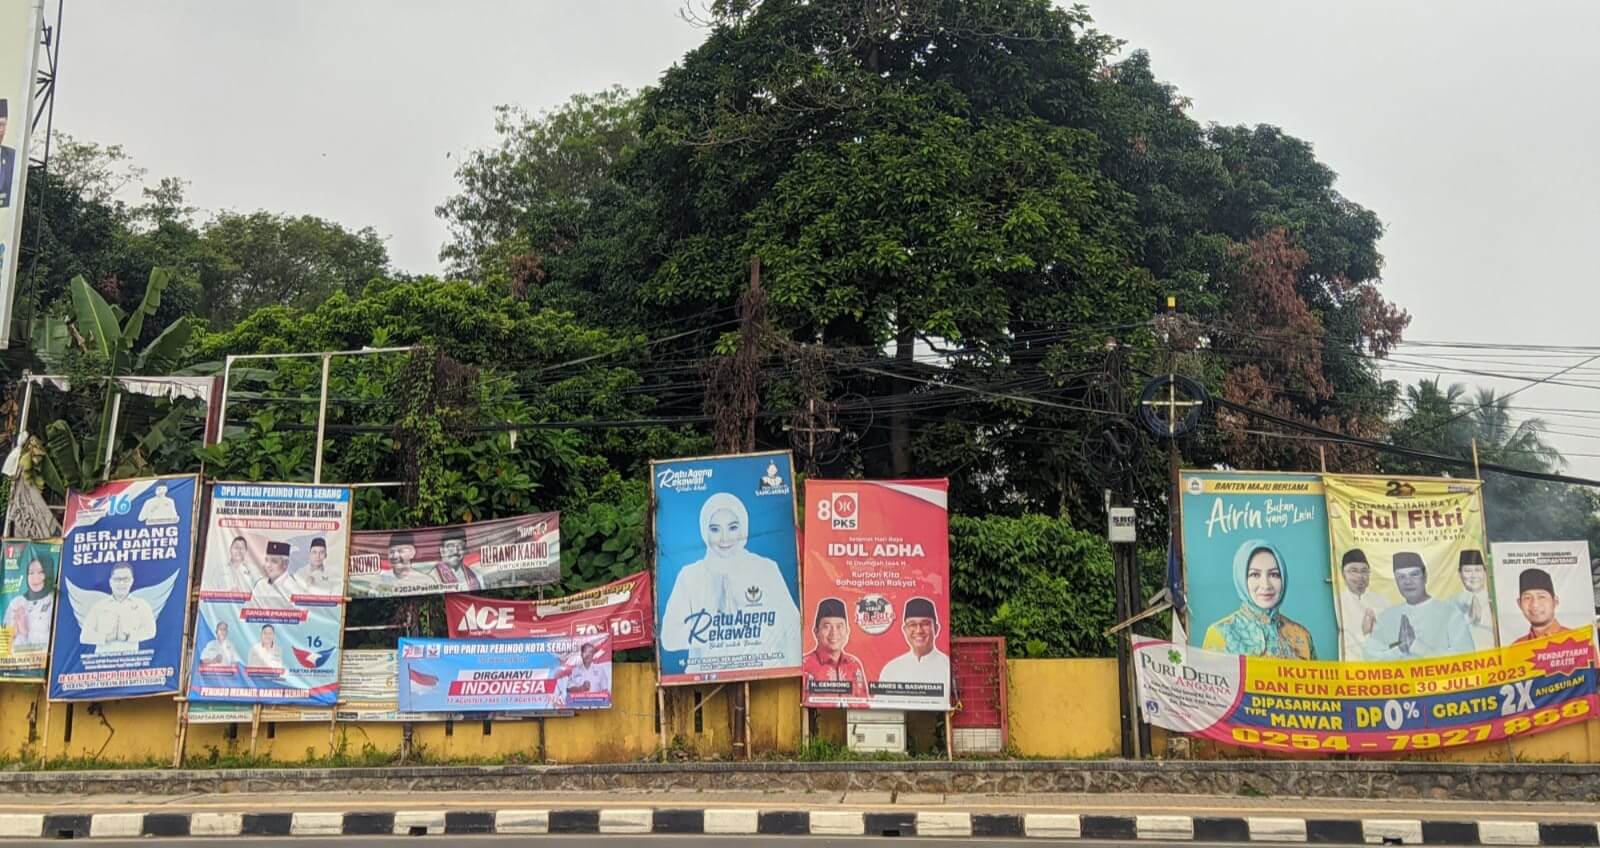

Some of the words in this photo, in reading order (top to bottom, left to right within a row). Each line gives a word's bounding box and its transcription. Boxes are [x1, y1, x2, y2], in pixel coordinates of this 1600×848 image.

[221, 486, 236, 496] DPD
[237, 487, 261, 497] PARTAI
[263, 487, 293, 497] PERINDO
[294, 488, 312, 498] KOTA
[313, 488, 342, 498] SERANG
[1273, 483, 1309, 491] BERSAMA
[108, 494, 131, 516] 16
[817, 500, 830, 520] 8
[1404, 501, 1427, 509] HARI
[1430, 499, 1460, 507] RAYA
[833, 519, 856, 528] PKS
[1205, 497, 1262, 538] Airin
[1264, 498, 1295, 513] Bukan
[1266, 513, 1289, 528] yang
[1350, 509, 1399, 529] Idul
[1408, 507, 1463, 529] Fitri
[74, 526, 178, 544] BERJUANG
[74, 541, 117, 553] UNTUK
[123, 537, 178, 549] BANTEN
[492, 544, 517, 564] RANO
[517, 541, 547, 561] KARNO
[828, 543, 869, 557] IDUL
[873, 543, 925, 557] ADHA
[72, 547, 177, 566] SEJAHTERA
[836, 579, 885, 587] Bahagiakan
[887, 579, 916, 588] Rakyat
[458, 603, 515, 630] ACE
[735, 610, 776, 627] Ageng
[306, 636, 322, 648] 16
[443, 644, 460, 655] DPD
[461, 645, 490, 655] PARTAI
[491, 644, 524, 654] PERINDO
[525, 644, 545, 653] KOTA
[547, 642, 577, 653] SERANG
[1537, 647, 1588, 661] PENDAFTARAN
[1550, 658, 1575, 667] GRATIS
[473, 671, 533, 680] DIRGAHAYU
[1140, 651, 1176, 678] PURI
[1182, 665, 1230, 688] DELTA
[1278, 666, 1339, 681] IKUTI!!!
[1345, 668, 1404, 680] LOMBA
[1410, 655, 1502, 678] MEWARNAI
[460, 681, 545, 695] INDONESIA
[1176, 676, 1232, 695] ANGSANA
[1254, 680, 1289, 694] DAN
[1294, 683, 1328, 695] FUN
[1335, 683, 1410, 696] AEROBIC
[1417, 682, 1437, 693] 30
[1442, 676, 1480, 690] JULI
[1488, 666, 1527, 684] 2023
[200, 687, 229, 697] PERINDO
[1433, 696, 1498, 718] GRATIS
[1500, 680, 1536, 716] 2X
[1535, 675, 1585, 697] ANGSURAN
[1244, 707, 1268, 716] TYPE
[1270, 713, 1343, 730] MAWAR
[1252, 696, 1341, 712] DIPASARKAN
[1355, 706, 1382, 728] DP
[1384, 699, 1420, 730] 0%
[1231, 728, 1350, 751] 0254
[1386, 724, 1492, 751] 7927
[1503, 700, 1590, 735] 888
